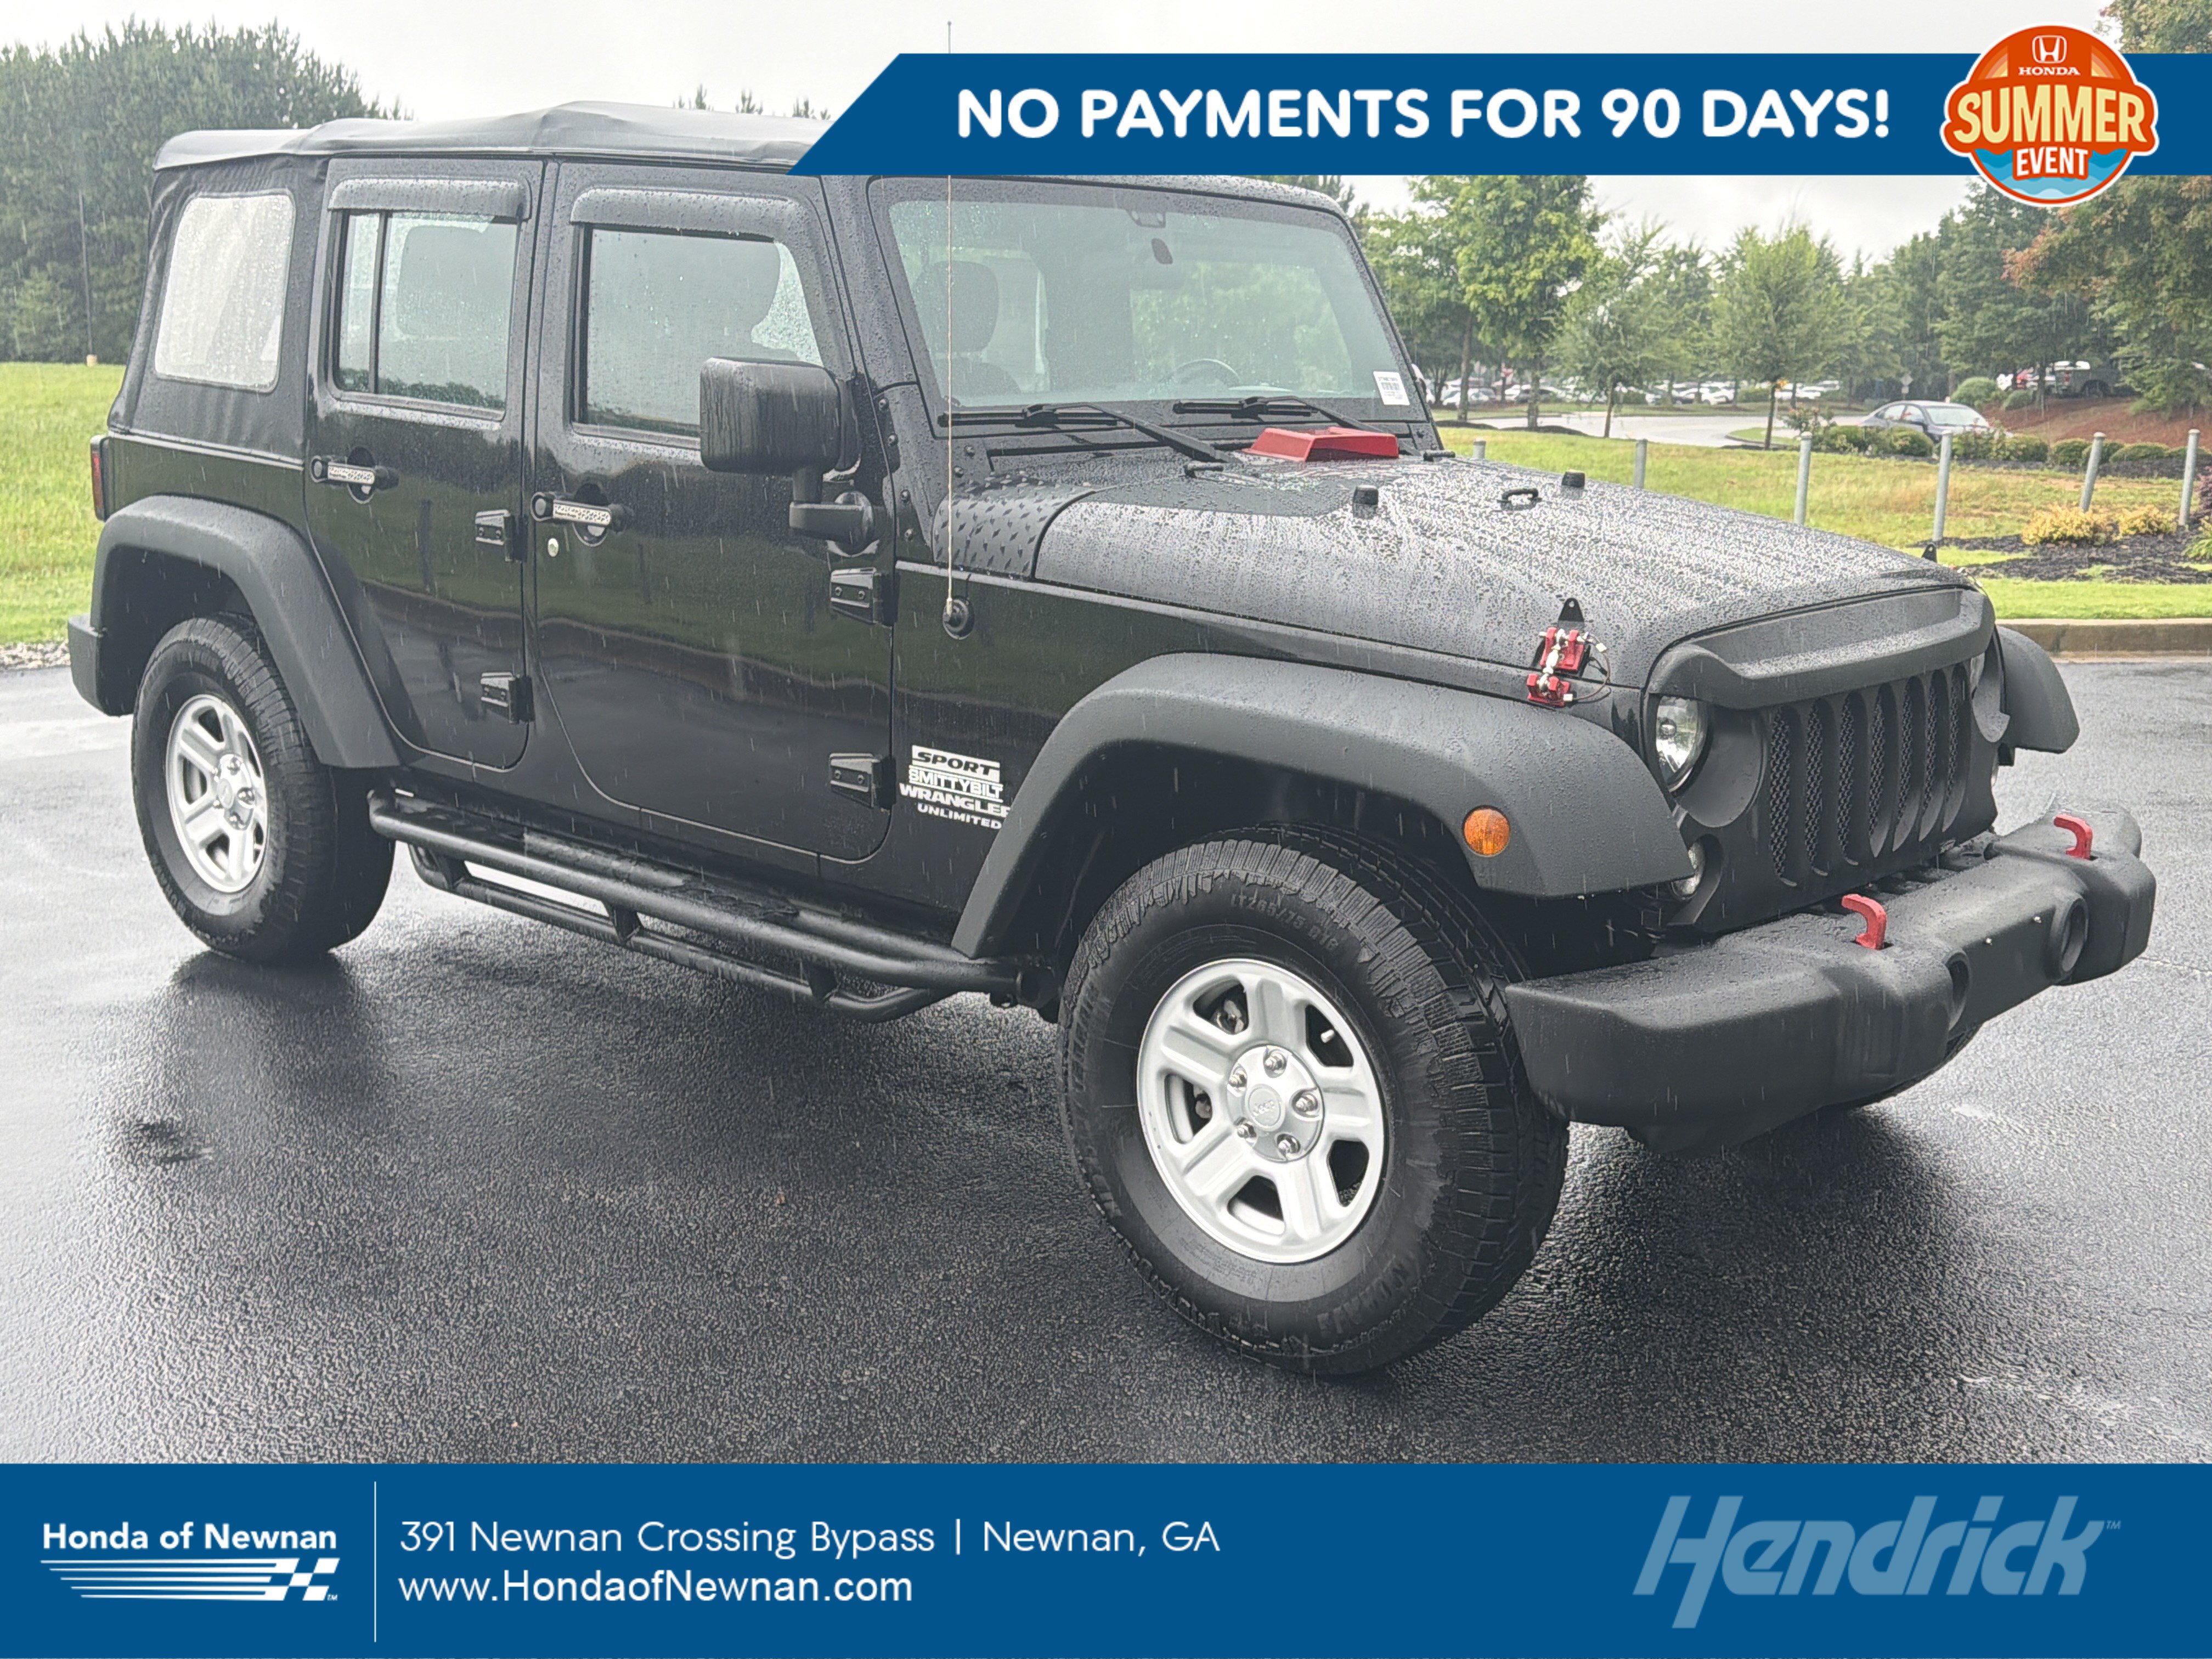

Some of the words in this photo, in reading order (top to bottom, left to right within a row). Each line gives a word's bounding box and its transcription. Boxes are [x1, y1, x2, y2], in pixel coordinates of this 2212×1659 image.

[917, 751, 999, 776] SPORT
[909, 768, 1003, 799] SMITTYBILT
[917, 803, 1002, 830] UNLIMITED
